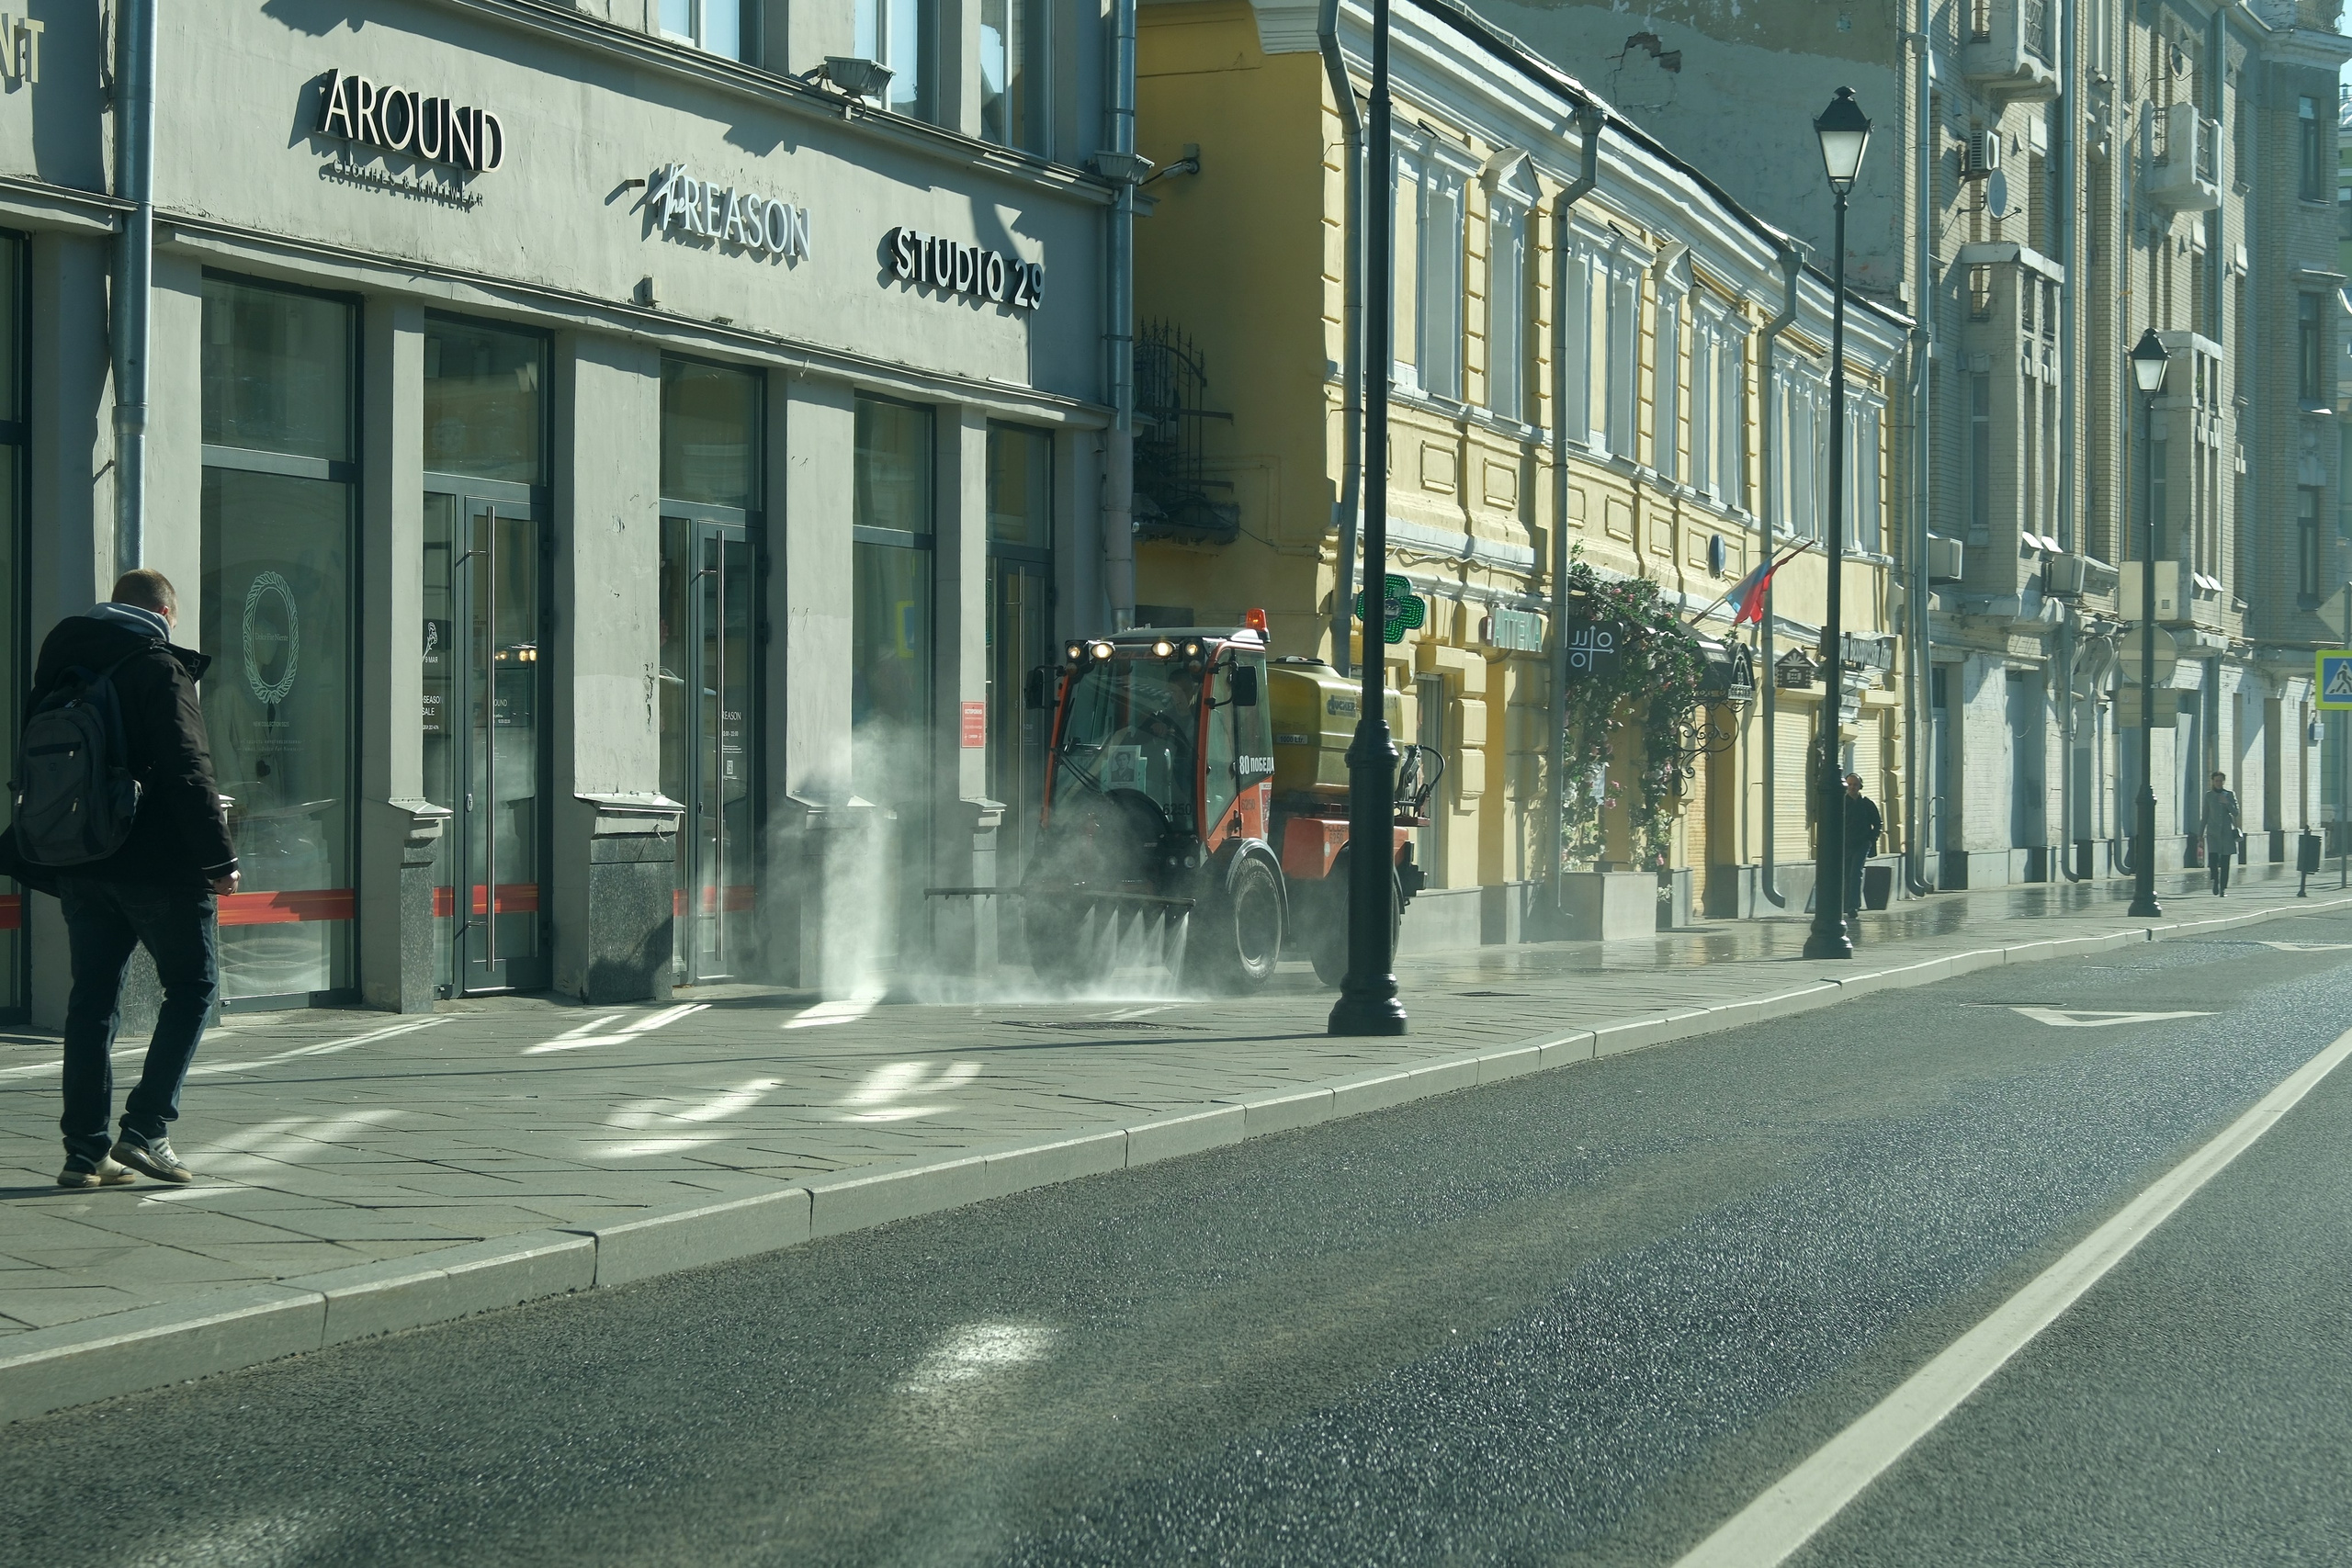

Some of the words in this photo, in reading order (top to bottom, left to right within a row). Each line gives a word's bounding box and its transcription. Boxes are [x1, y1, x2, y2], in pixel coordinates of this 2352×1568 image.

[322, 68, 505, 174] AROUND
[332, 158, 396, 186] CLOTHES
[402, 175, 411, 190] &
[417, 178, 483, 208] KNITWEAR
[651, 163, 688, 231] The
[683, 175, 810, 262] REASON
[896, 226, 1005, 302] STUDIO
[1014, 257, 1046, 310] 29
[1493, 607, 1543, 653] АПТЕКА
[423, 707, 435, 716] SALE
[1238, 755, 1250, 775] 80
[1163, 803, 1193, 816] 6250
